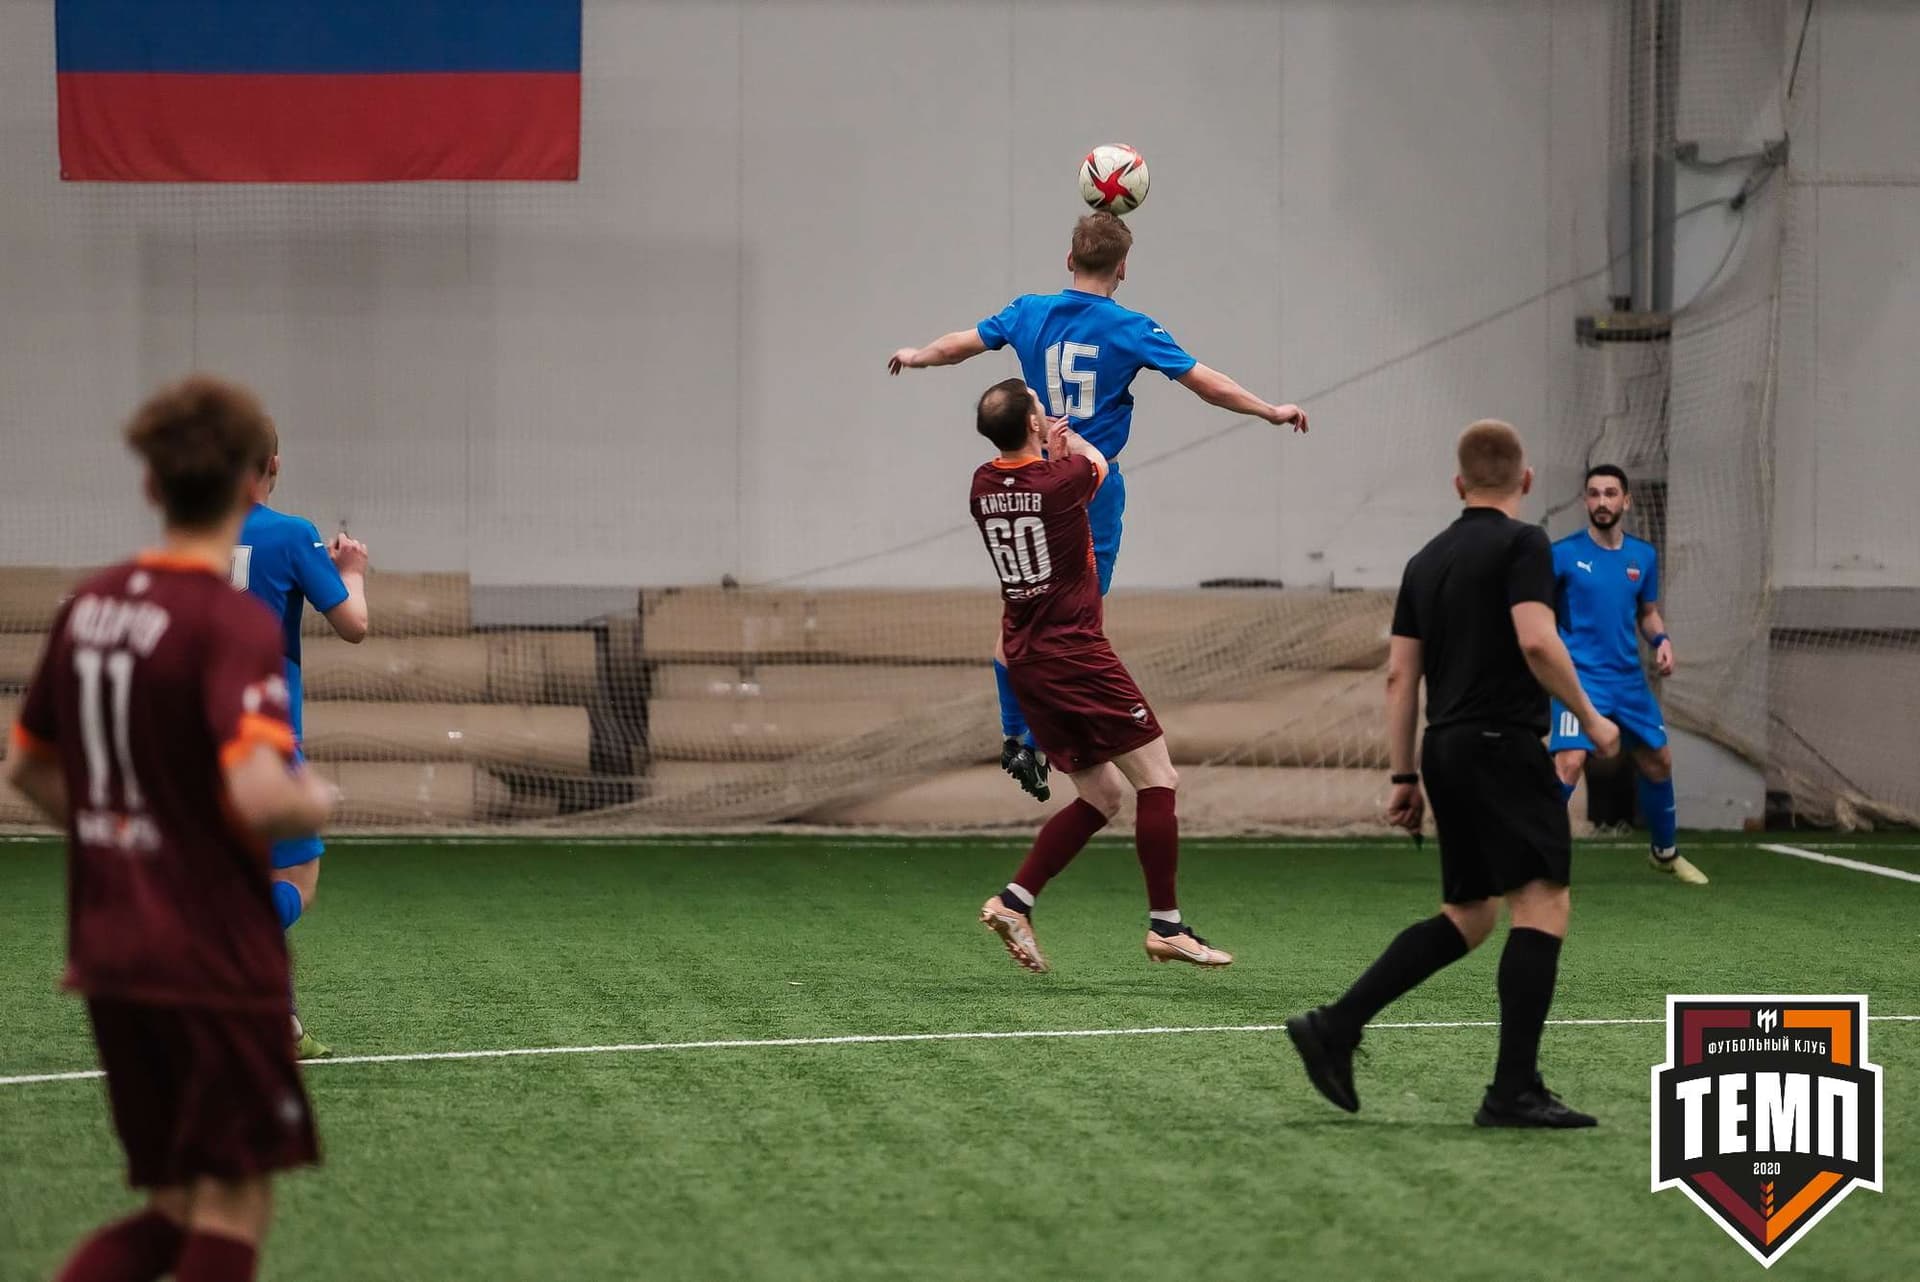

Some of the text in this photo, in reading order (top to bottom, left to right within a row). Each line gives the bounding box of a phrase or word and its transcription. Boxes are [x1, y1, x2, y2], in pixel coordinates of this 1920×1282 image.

[1045, 340, 1100, 420] 15
[980, 493, 1042, 515] КИСЕЛЕВ
[985, 516, 1052, 584] 60
[72, 648, 142, 808] 11
[1559, 711, 1579, 737] 10
